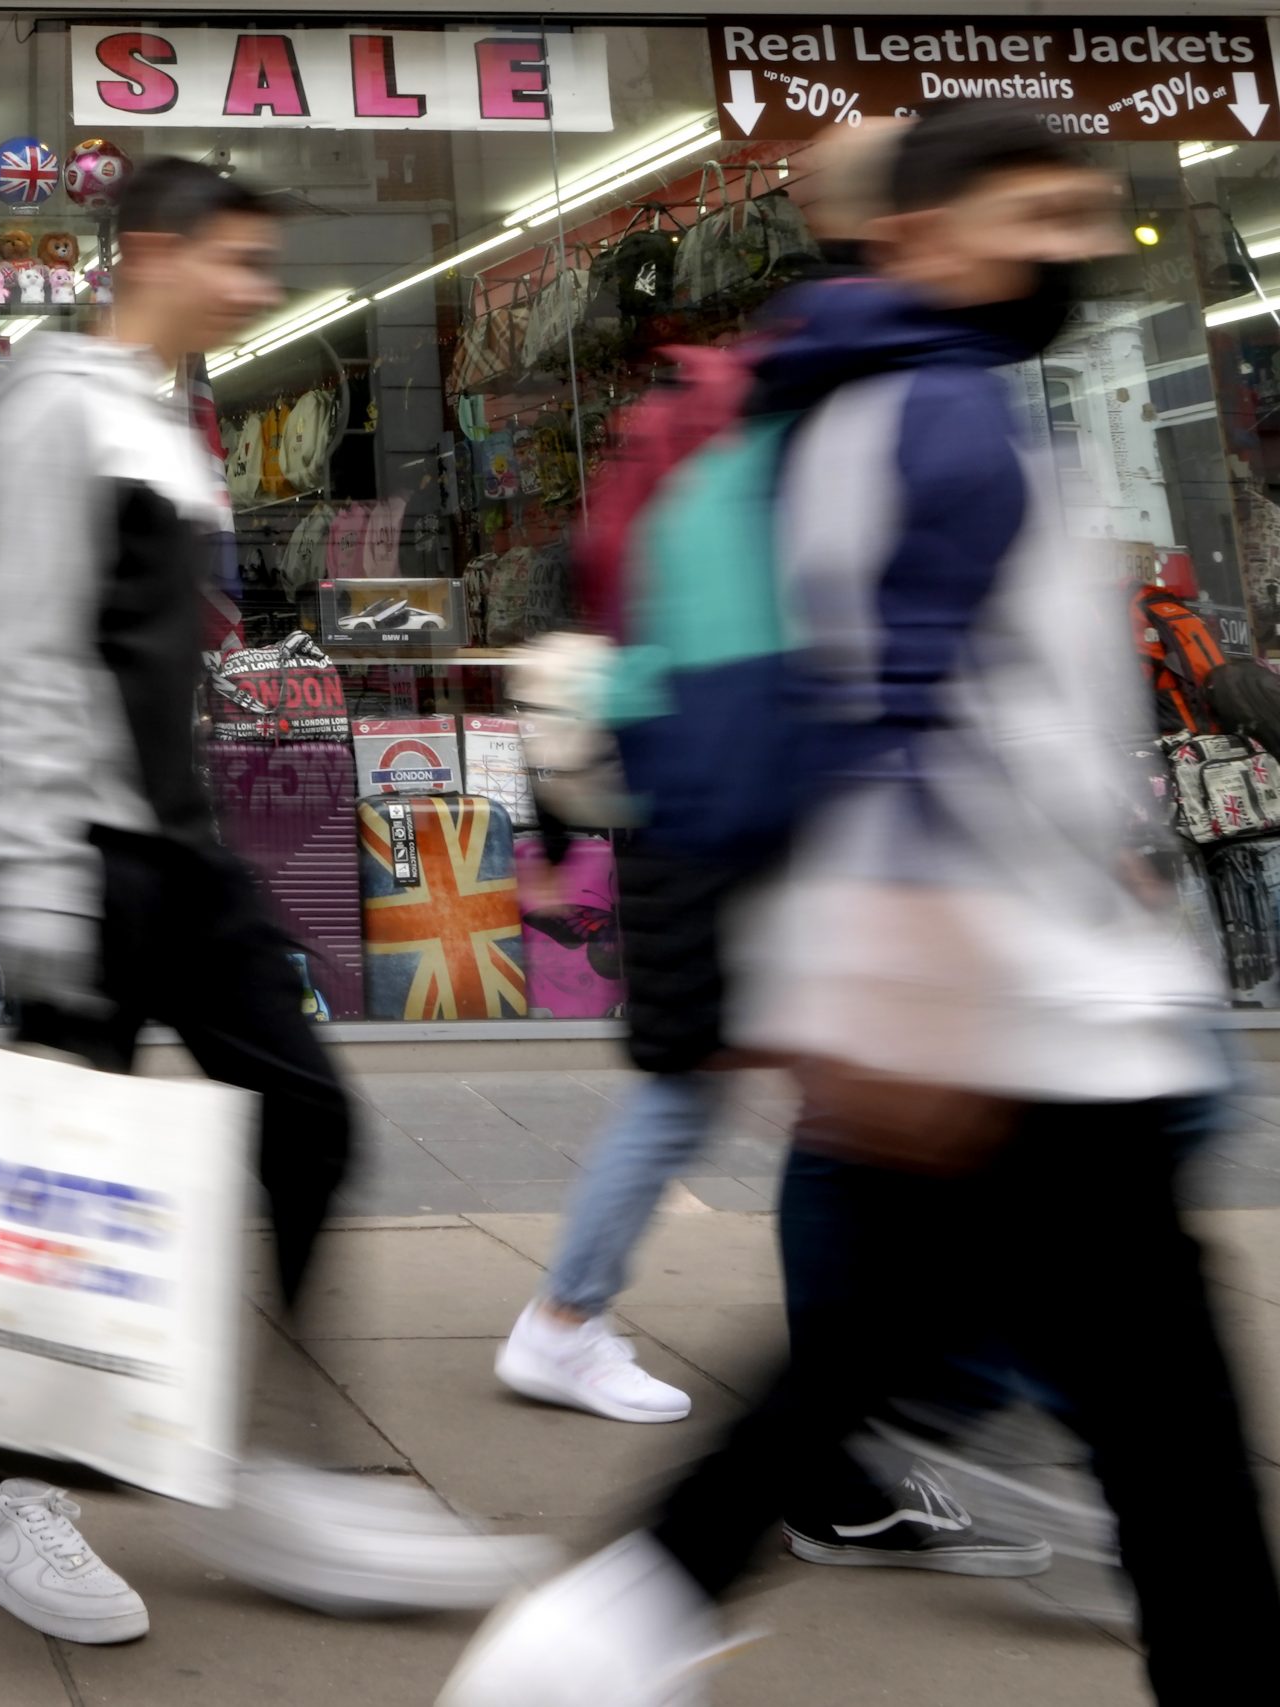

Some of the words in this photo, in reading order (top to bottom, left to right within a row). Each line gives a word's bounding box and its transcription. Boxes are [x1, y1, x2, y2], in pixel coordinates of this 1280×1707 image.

[723, 24, 836, 61] Real
[853, 25, 1053, 62] Leather
[1068, 26, 1255, 63] Jackets
[95, 32, 552, 119] SALE
[920, 71, 1074, 100] Downstairs
[763, 69, 778, 82] up
[779, 71, 791, 83] to
[785, 76, 863, 128] 50%
[1108, 101, 1122, 112] up
[1122, 97, 1133, 107] to
[1132, 71, 1210, 124] 50%
[1212, 86, 1227, 99] off
[390, 771, 433, 781] LONDON
[409, 842, 417, 878] COLLECTION
